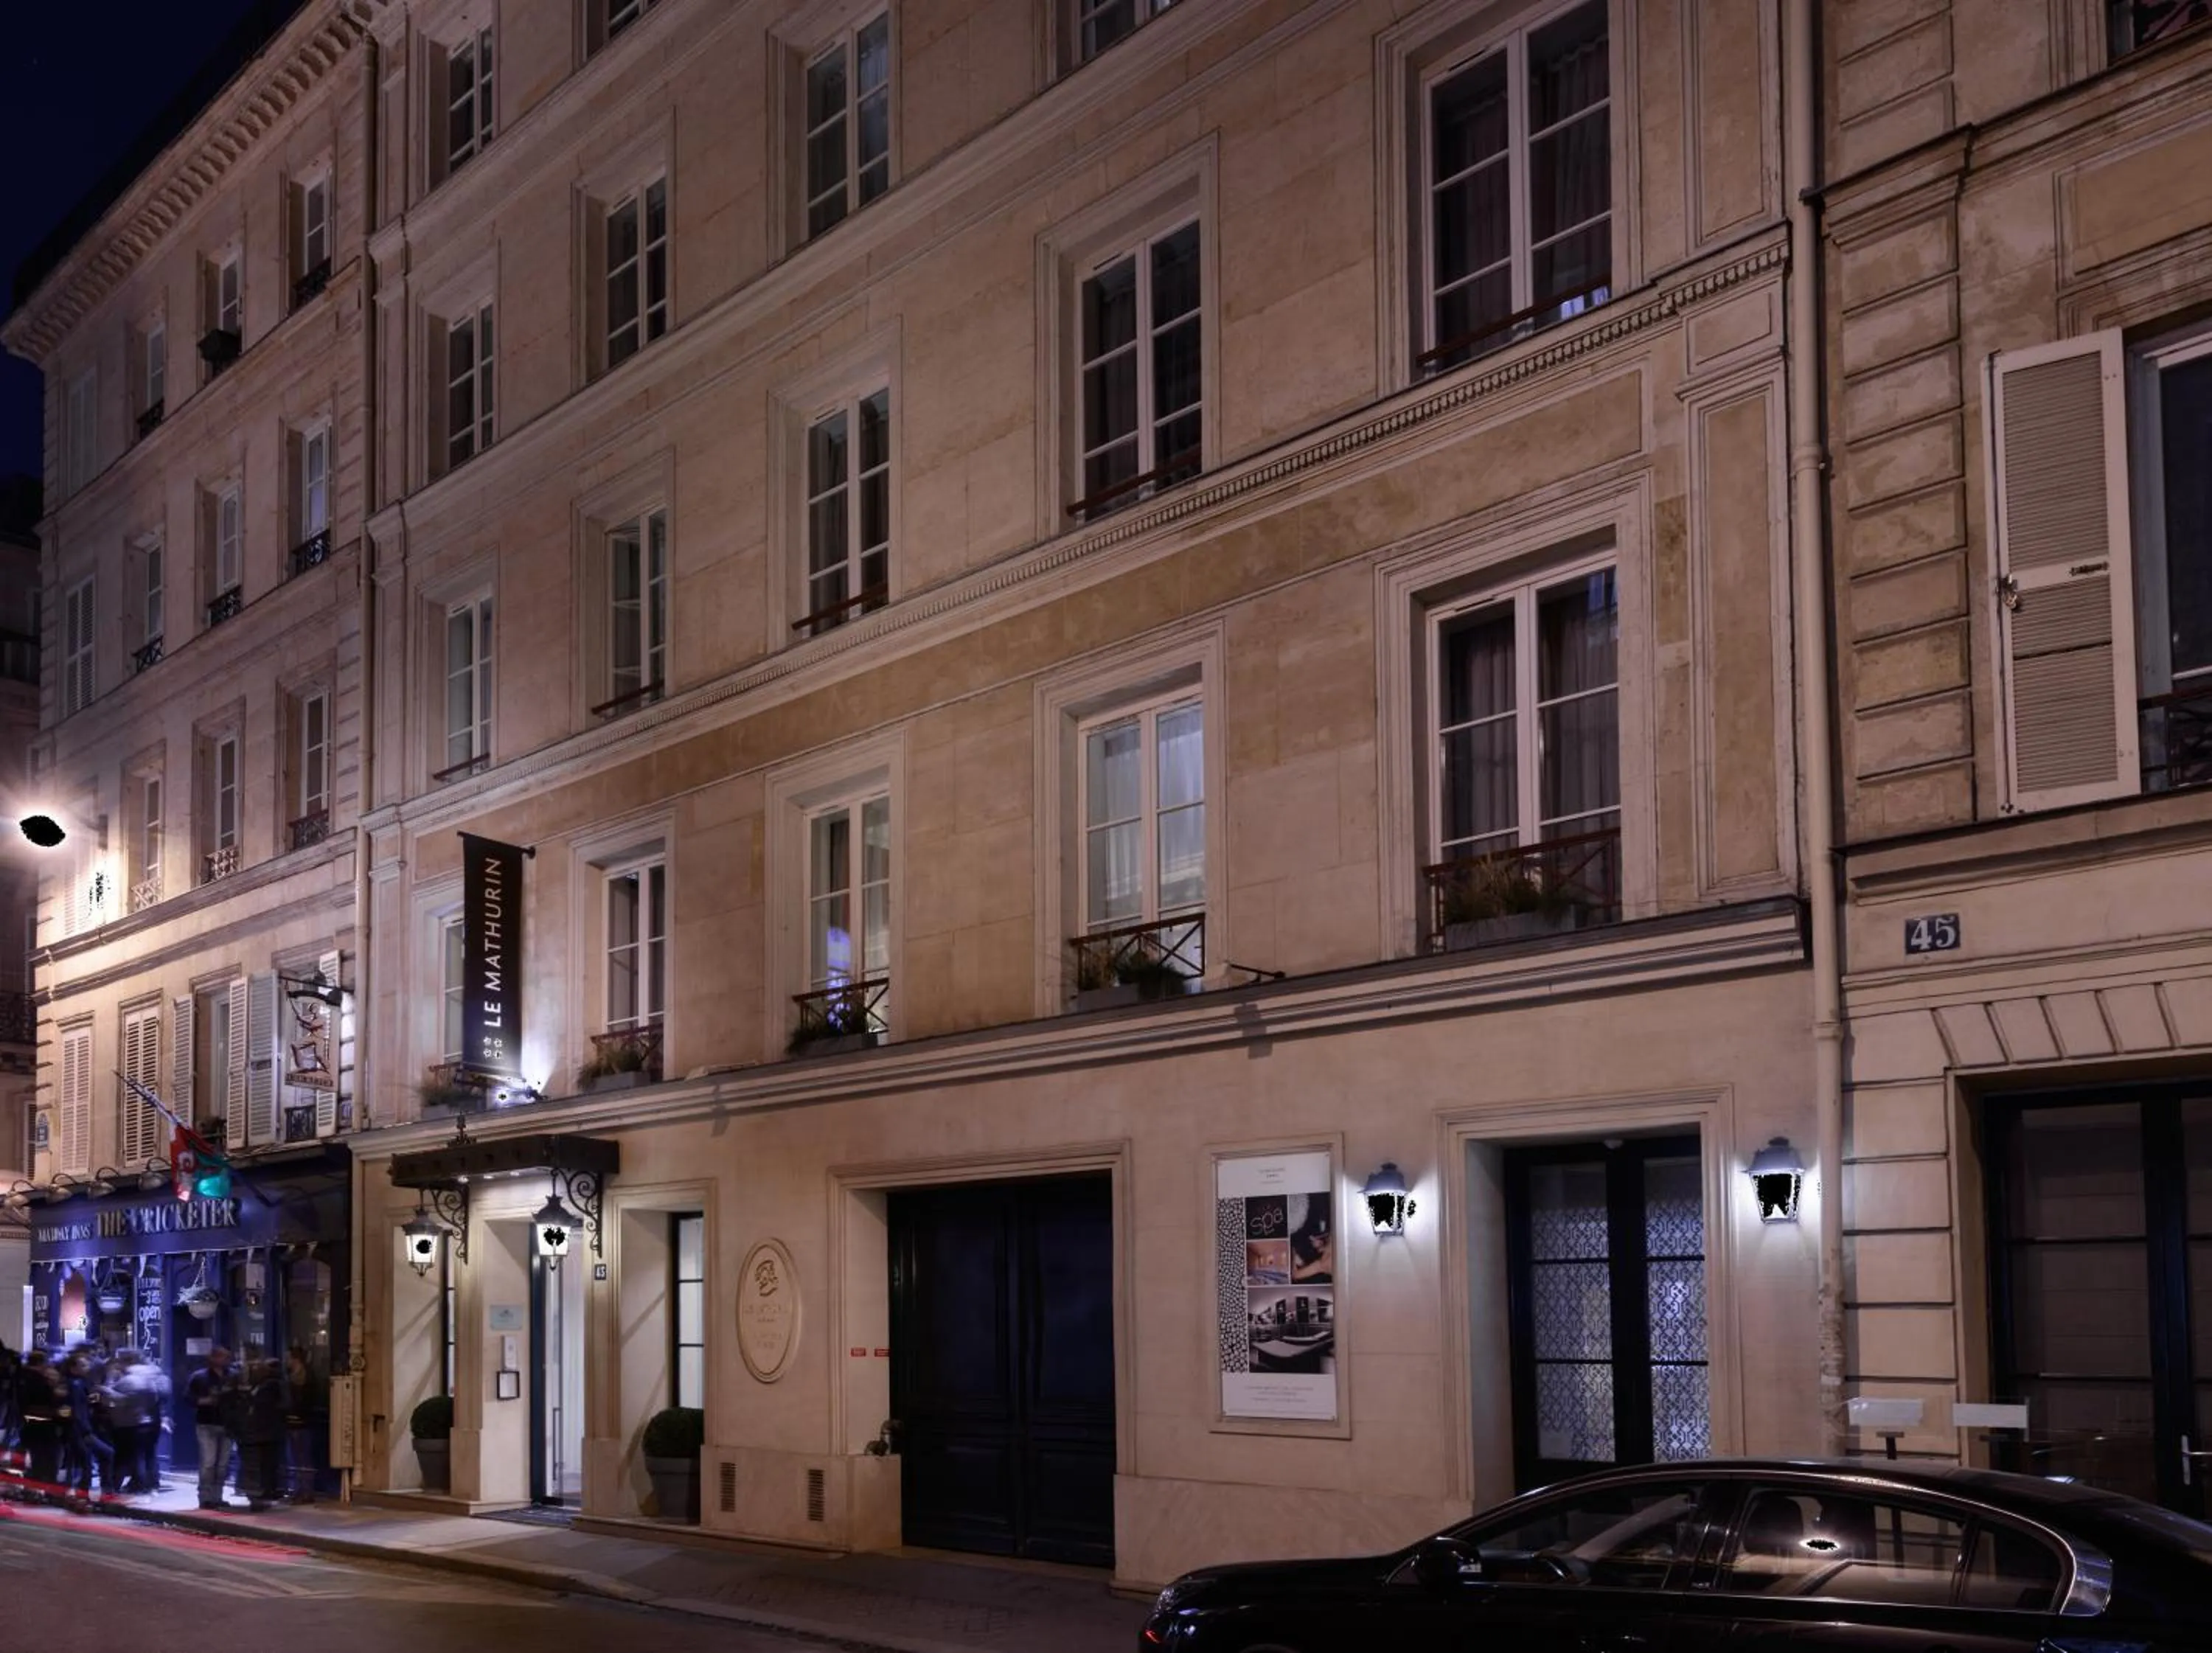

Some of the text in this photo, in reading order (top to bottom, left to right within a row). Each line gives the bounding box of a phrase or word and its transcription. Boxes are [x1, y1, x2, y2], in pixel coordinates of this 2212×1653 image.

[484, 857, 502, 1027] LE MATHURIN
[1910, 915, 1956, 950] 45
[97, 1198, 237, 1237] THE CRICKETER
